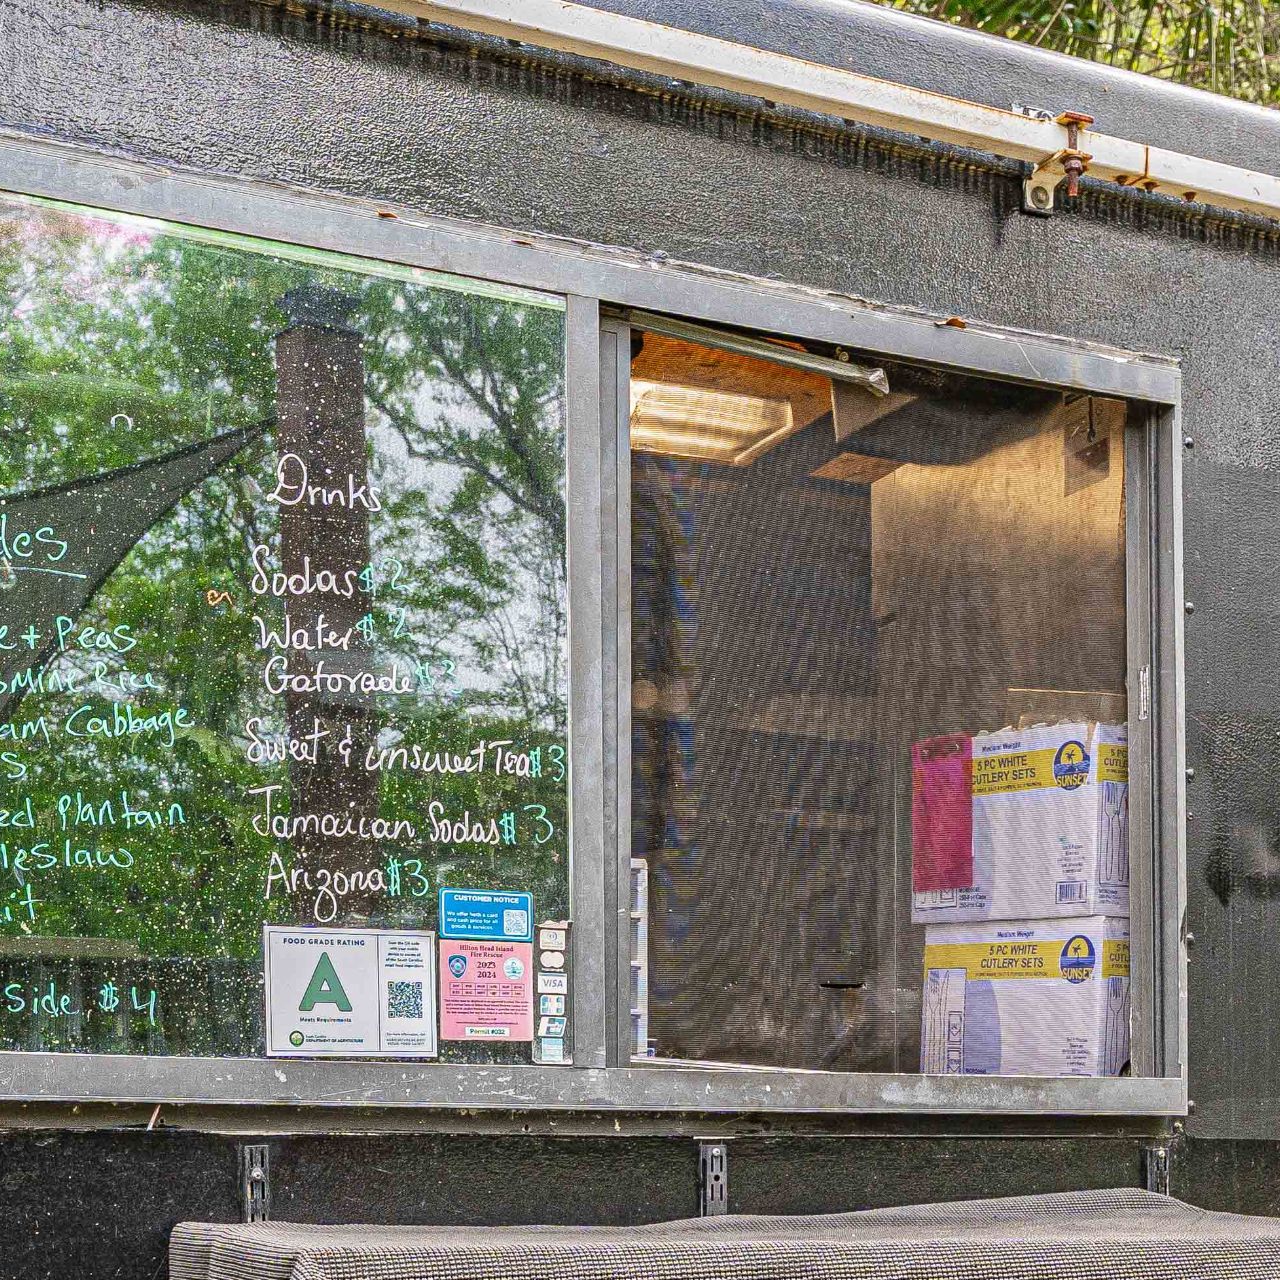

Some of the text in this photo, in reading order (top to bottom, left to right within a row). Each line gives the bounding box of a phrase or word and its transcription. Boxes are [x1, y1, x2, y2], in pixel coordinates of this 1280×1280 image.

[267, 452, 382, 513] Drinks
[251, 544, 358, 597] Sodas
[56, 616, 138, 652] Peas
[253, 614, 353, 651] Water
[95, 666, 162, 692] Rice
[264, 655, 413, 695] Gatorade
[66, 702, 195, 748] Cabbage
[245, 717, 330, 764] Sweet
[491, 740, 530, 777] Tea
[984, 759, 996, 770] PC
[998, 755, 1027, 768] WHITE
[972, 768, 1036, 785] CUTLERY SETS
[58, 792, 186, 831] Plantain
[248, 785, 416, 839] Jamaican
[429, 801, 501, 845] Sodas
[263, 851, 389, 922] Arizona
[453, 894, 519, 904] CUSTOMER NOTICE
[283, 937, 306, 945] FOOD
[308, 938, 335, 946] GRADE
[997, 945, 1008, 955] PC
[1011, 945, 1037, 955] WHITE
[476, 961, 496, 969] 2023
[477, 971, 496, 979] 2024
[981, 957, 1043, 968] CUTLERY SETS
[1061, 967, 1091, 979] SUNSET
[298, 951, 353, 1012] A
[543, 978, 563, 987] VISA
[5, 982, 80, 1017] Side
